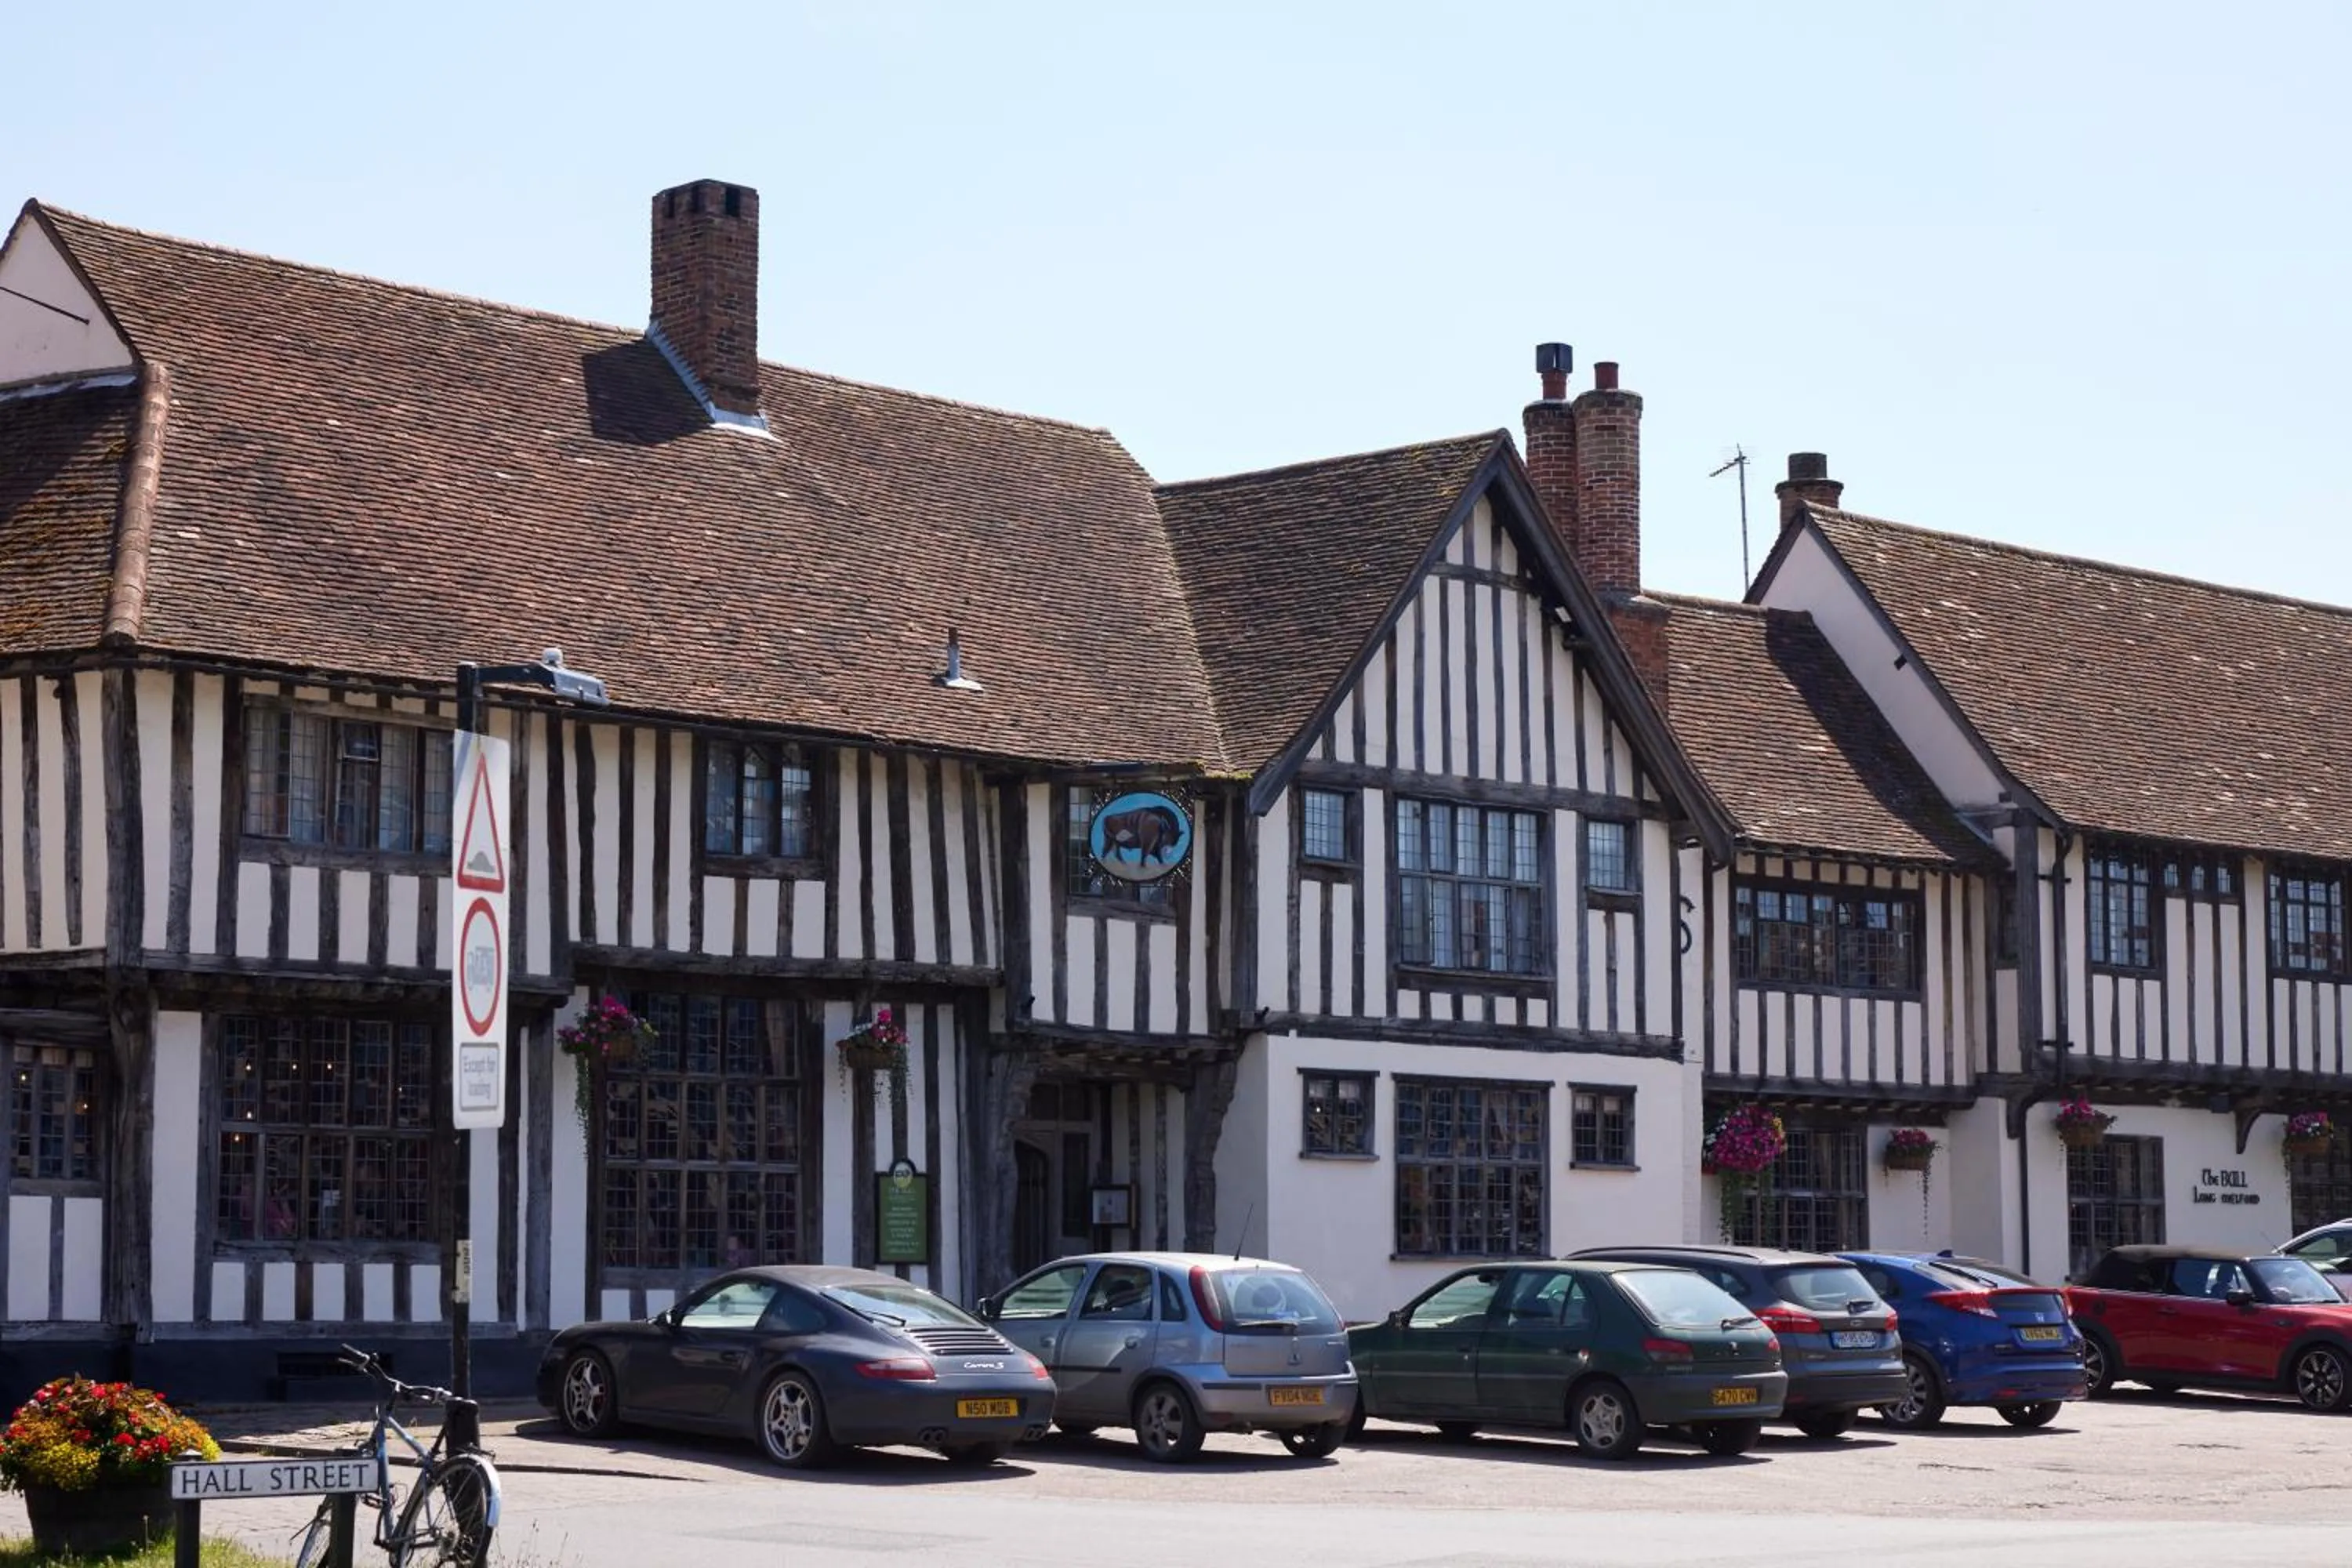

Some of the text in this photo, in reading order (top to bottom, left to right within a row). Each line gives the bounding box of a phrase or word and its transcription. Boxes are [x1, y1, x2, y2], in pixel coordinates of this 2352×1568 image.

[2201, 1168, 2248, 1188] The BULL
[182, 1464, 369, 1494] HALL STREET
